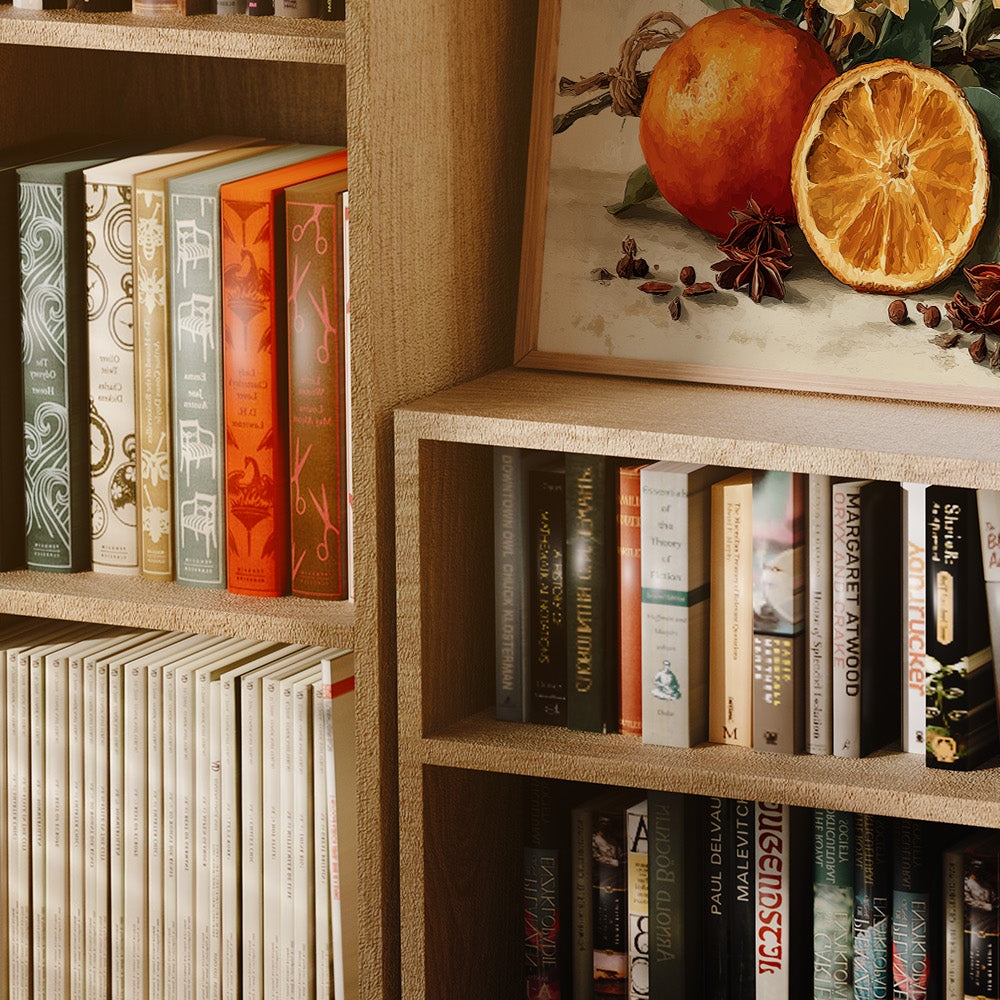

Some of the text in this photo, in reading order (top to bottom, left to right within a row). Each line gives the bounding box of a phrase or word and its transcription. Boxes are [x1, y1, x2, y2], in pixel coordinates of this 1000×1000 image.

[502, 455, 515, 691] DOWNTOWN OWL CHUCK KLOSTERMAN
[833, 492, 847, 670] ORYX AND CRAKE
[845, 492, 861, 698] MARGARET ATWOOD
[710, 797, 722, 916] PAUL DELVAU
